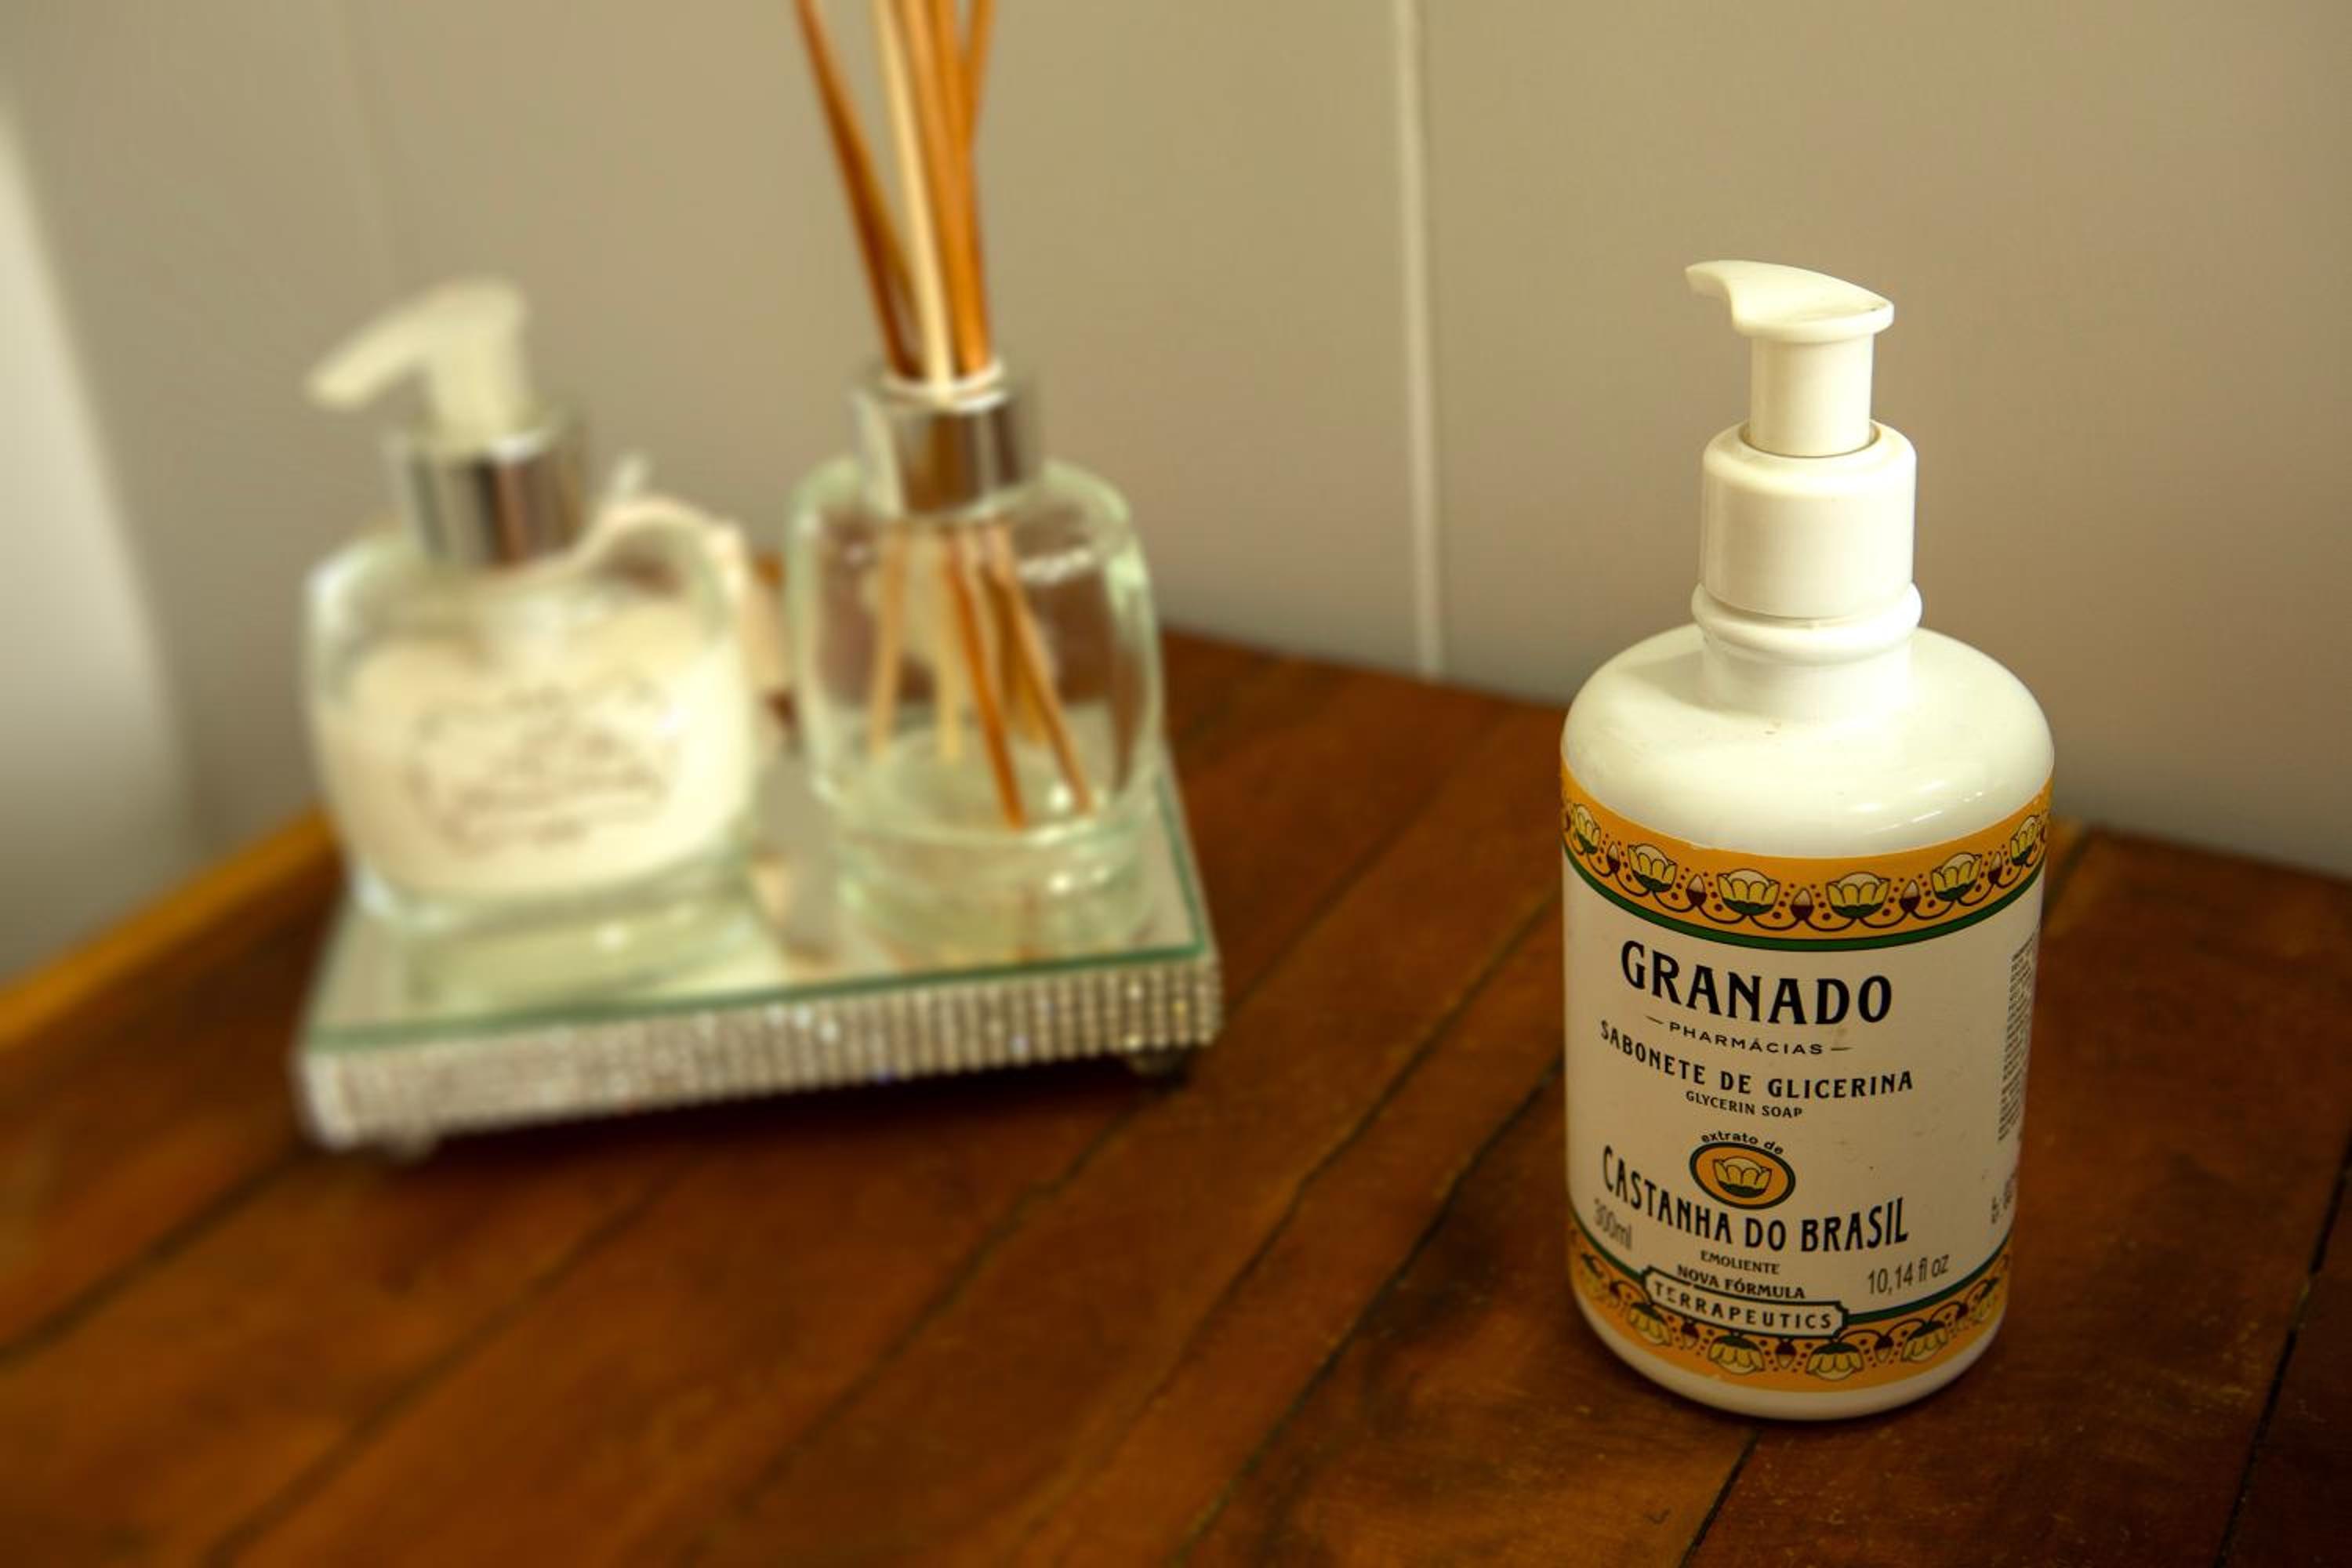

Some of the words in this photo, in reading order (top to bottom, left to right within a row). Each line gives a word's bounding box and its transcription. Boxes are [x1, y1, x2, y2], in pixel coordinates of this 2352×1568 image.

[1621, 940, 1893, 1025] GRANADO
[1669, 1021, 1824, 1054] PHARMÁCIAS
[1600, 1019, 1706, 1084] SABONETE
[1720, 1071, 1752, 1094] DE
[1767, 1070, 1914, 1099] GLICERINA
[1686, 1090, 1756, 1115] GLYCERIN
[1761, 1104, 1803, 1119] SOAP
[1700, 1130, 1759, 1146] extrato
[1763, 1139, 1784, 1155] de
[1602, 1145, 1733, 1244] CASTANHA
[1744, 1218, 1787, 1251] DO
[1800, 1197, 1908, 1252] BRASIL
[1677, 1264, 1720, 1288] NOVA
[1725, 1278, 1806, 1299] FÓRMULA
[1700, 1250, 1780, 1275] EMOLIENTE
[1867, 1266, 1914, 1295] 10,14
[1931, 1254, 1950, 1276] oz
[1653, 1280, 1833, 1330] TERRAPEUTICS
